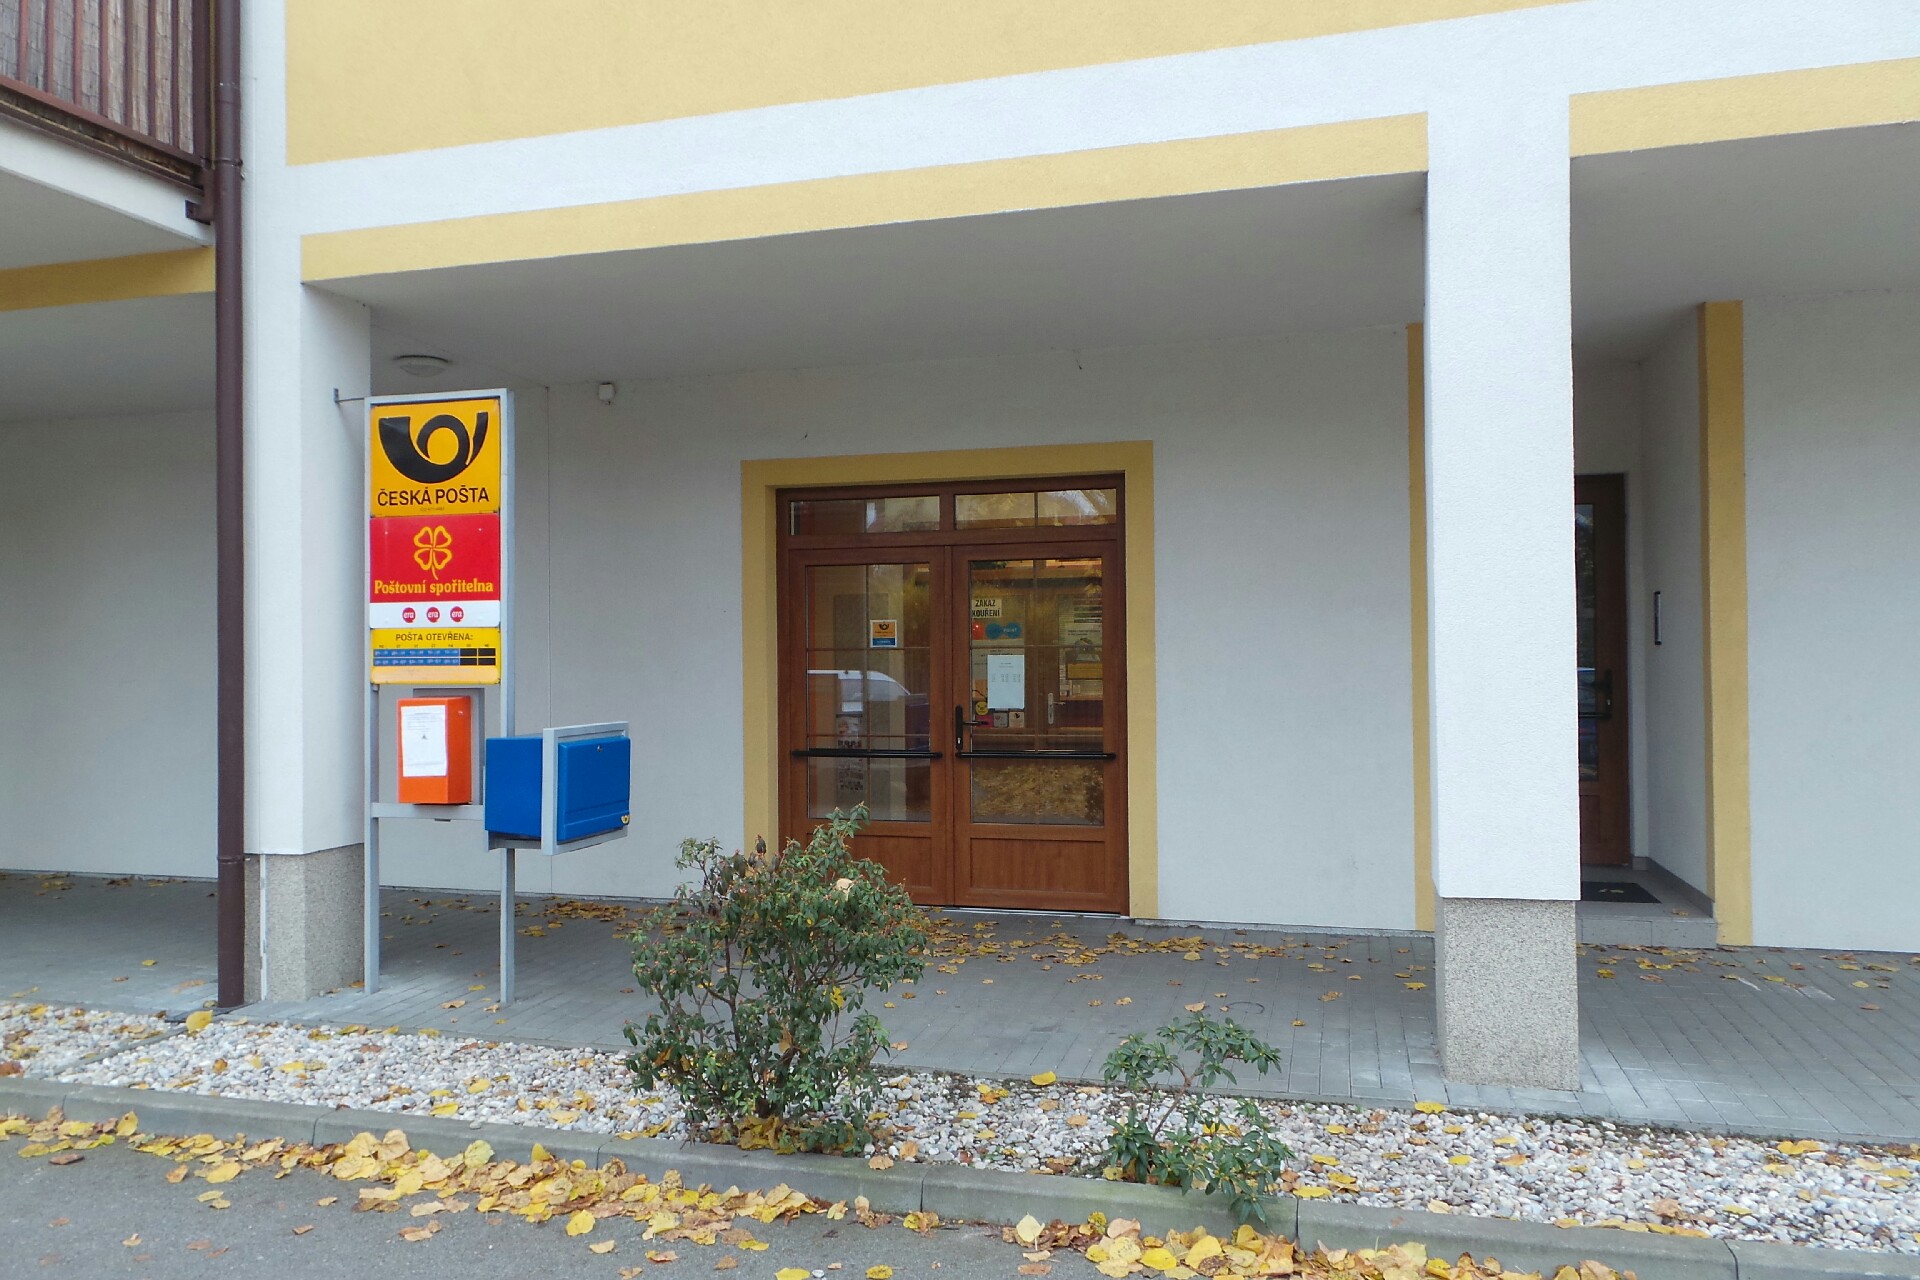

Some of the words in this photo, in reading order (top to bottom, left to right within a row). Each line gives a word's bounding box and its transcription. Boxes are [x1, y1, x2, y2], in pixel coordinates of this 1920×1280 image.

[377, 487, 431, 506] ČESKÁ
[435, 485, 489, 504] POŠTA
[374, 580, 426, 594] Poštovní
[429, 578, 493, 596] spořitelna
[427, 610, 438, 618] era
[451, 609, 462, 617] era
[395, 632, 423, 641] POŠTA
[426, 630, 473, 641] OTEVŘENA:
